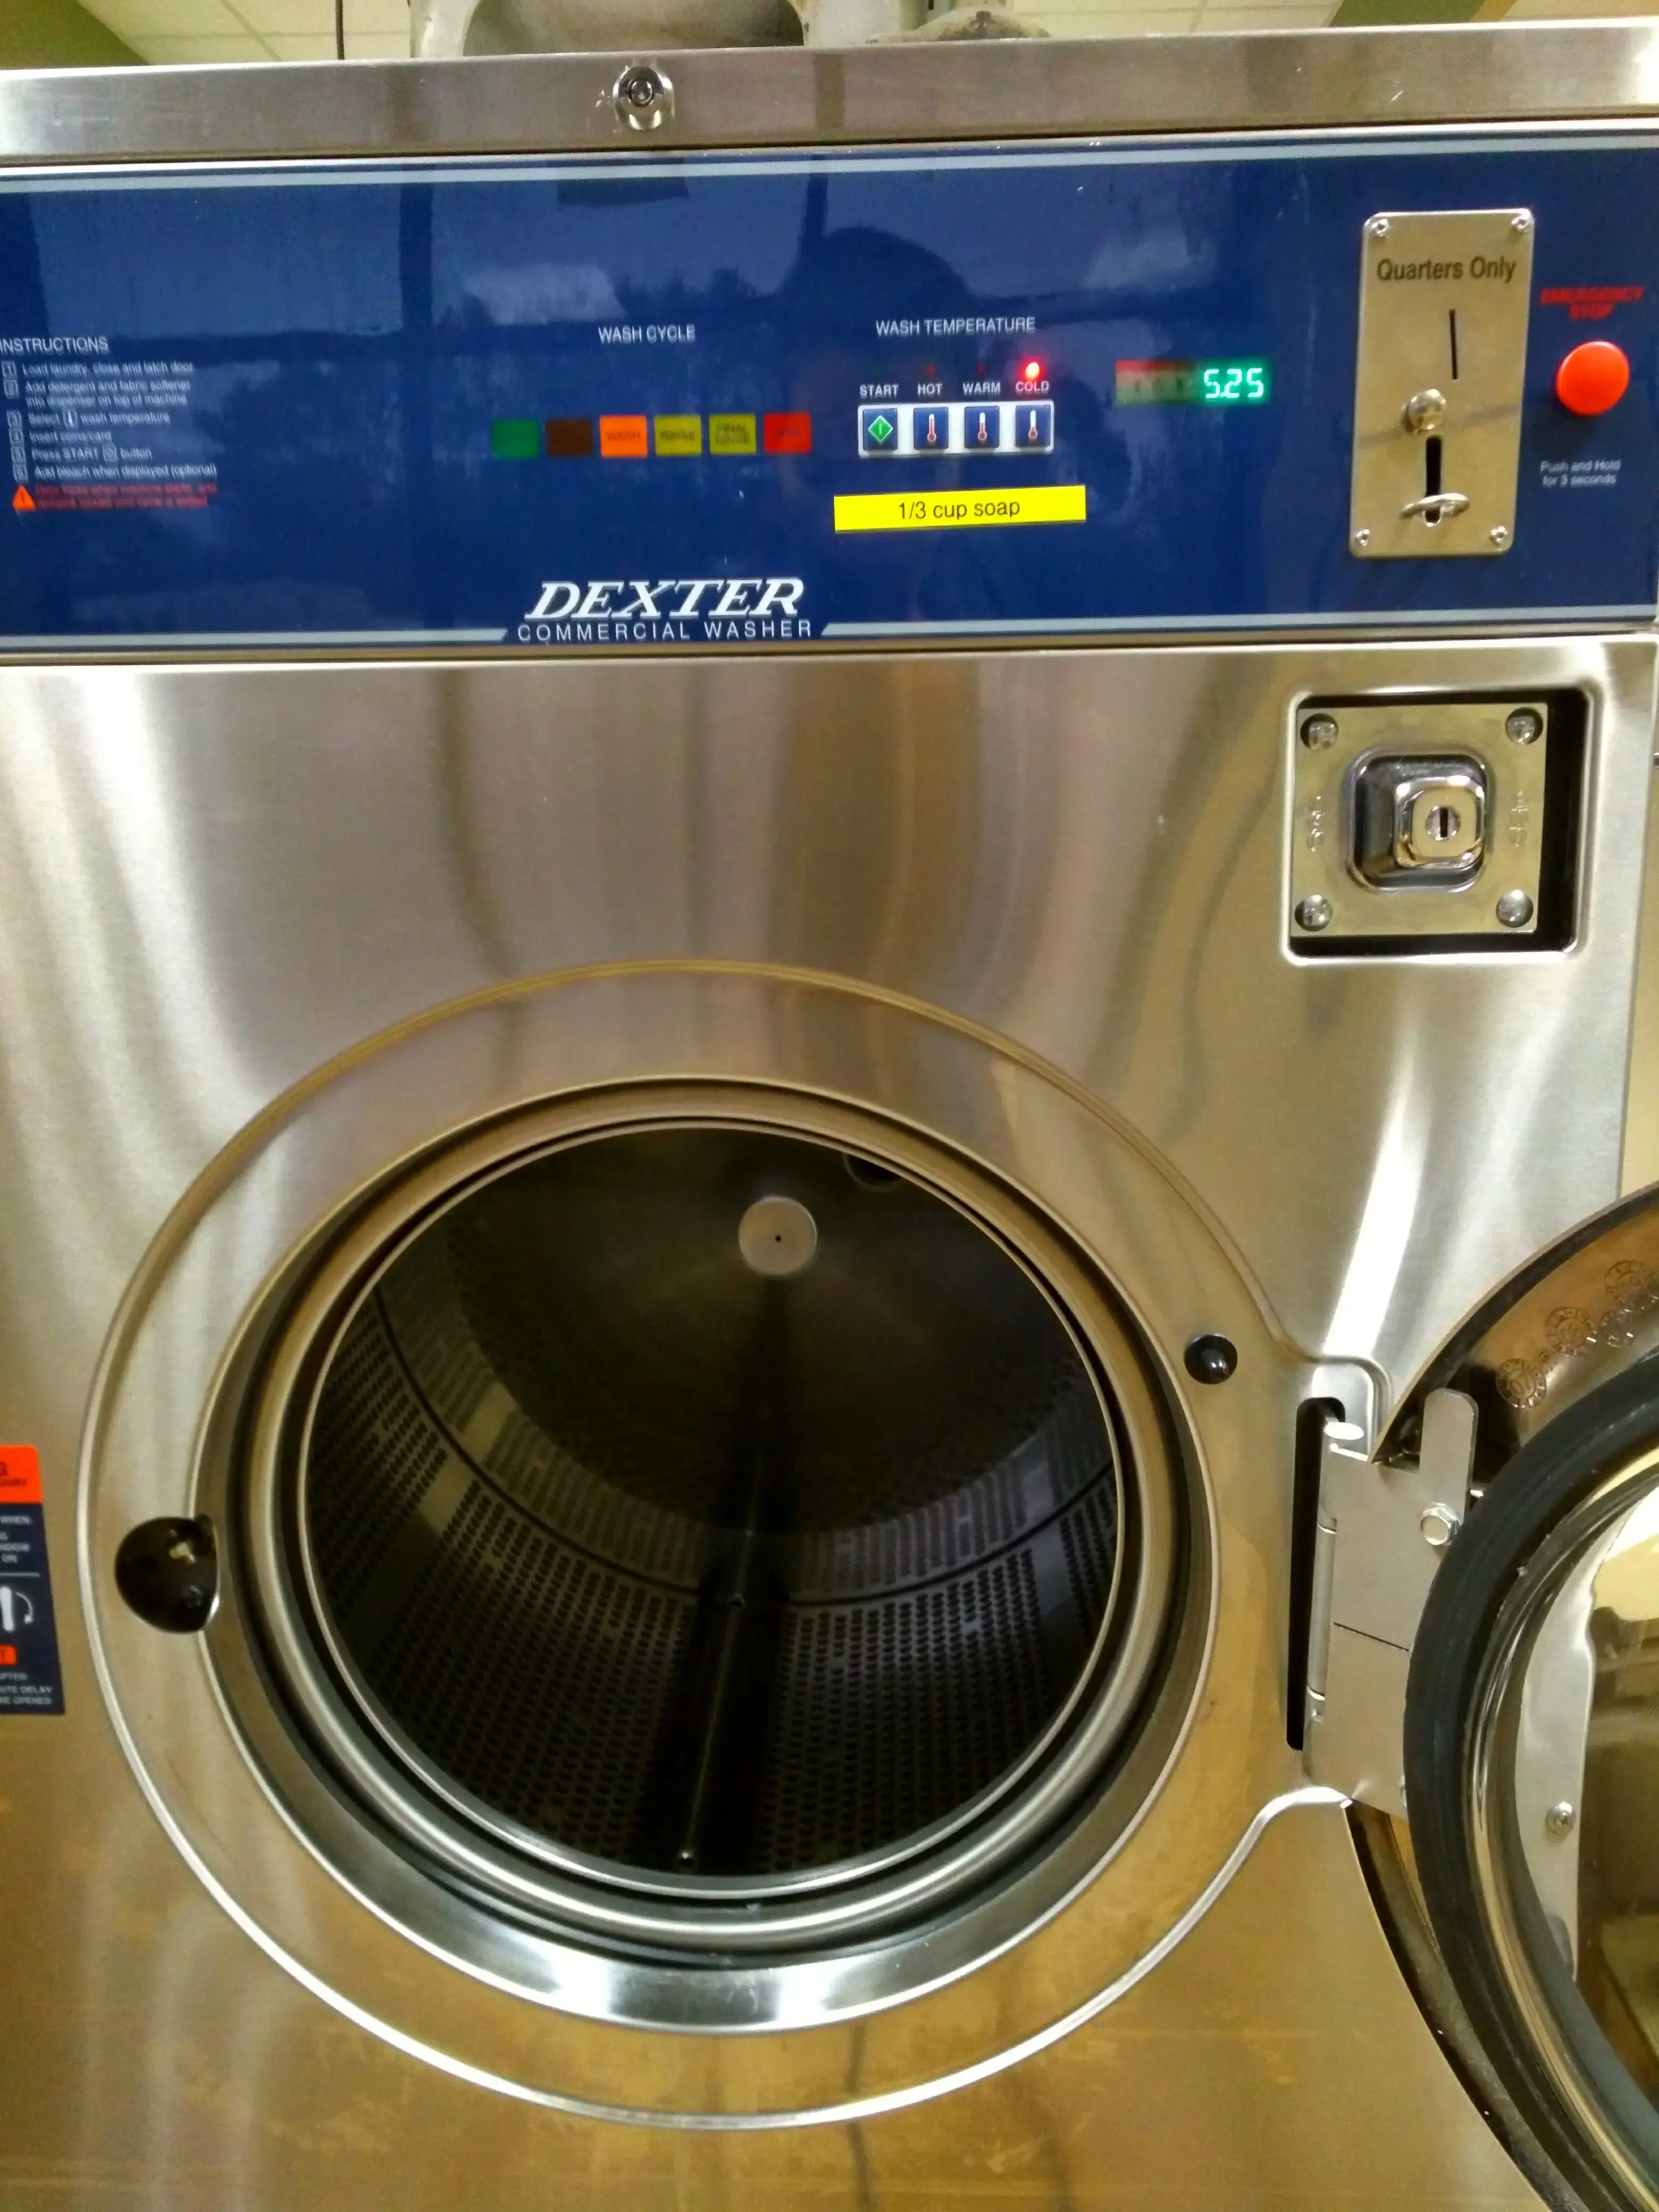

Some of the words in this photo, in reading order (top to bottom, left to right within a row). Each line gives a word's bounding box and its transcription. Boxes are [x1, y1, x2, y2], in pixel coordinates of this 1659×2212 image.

[1377, 258, 1463, 281] Quarters
[1470, 256, 1516, 284] Only
[598, 325, 642, 345] WASH
[647, 324, 696, 343] CYCLE
[876, 320, 920, 338] WASH
[925, 317, 1035, 336] TEMPERATURE
[0, 336, 110, 355] INSTRUCTIONS
[860, 384, 899, 399] START
[918, 383, 943, 396] HOT
[963, 381, 1001, 396] WARM
[1016, 381, 1050, 394] COLD
[899, 501, 927, 520] 1/3
[933, 505, 967, 520] cup
[974, 501, 1020, 517] soap
[524, 577, 803, 620] DEXTER
[518, 621, 690, 643] COMMERCIAL
[705, 619, 811, 639] WASHER
